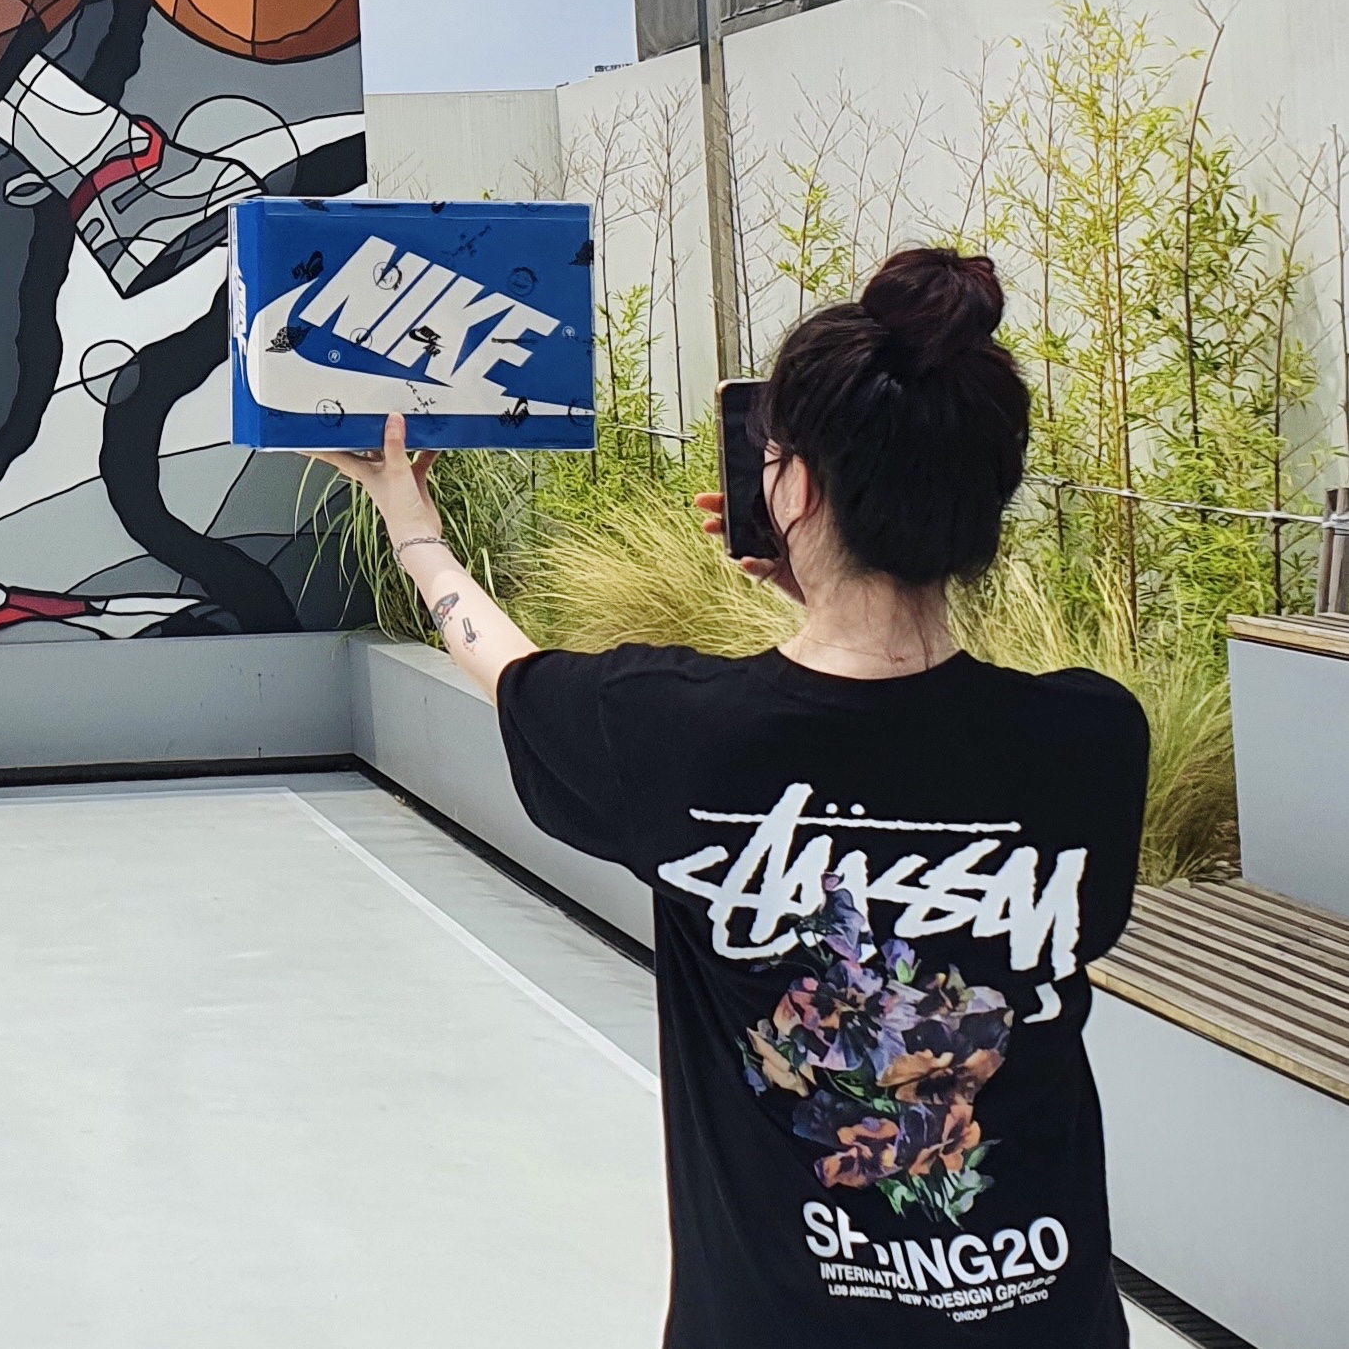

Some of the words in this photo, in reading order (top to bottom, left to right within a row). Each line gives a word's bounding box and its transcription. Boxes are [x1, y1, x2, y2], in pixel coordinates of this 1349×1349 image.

[298, 235, 561, 395] NIKE
[820, 1262, 914, 1290] INTERNATIO
[929, 1286, 993, 1309] DESIGN
[828, 1283, 848, 1297] LOS
[850, 1285, 893, 1300] ANGELES
[947, 1308, 988, 1322] ONDON
[1019, 1289, 1049, 1305] TOKYO
